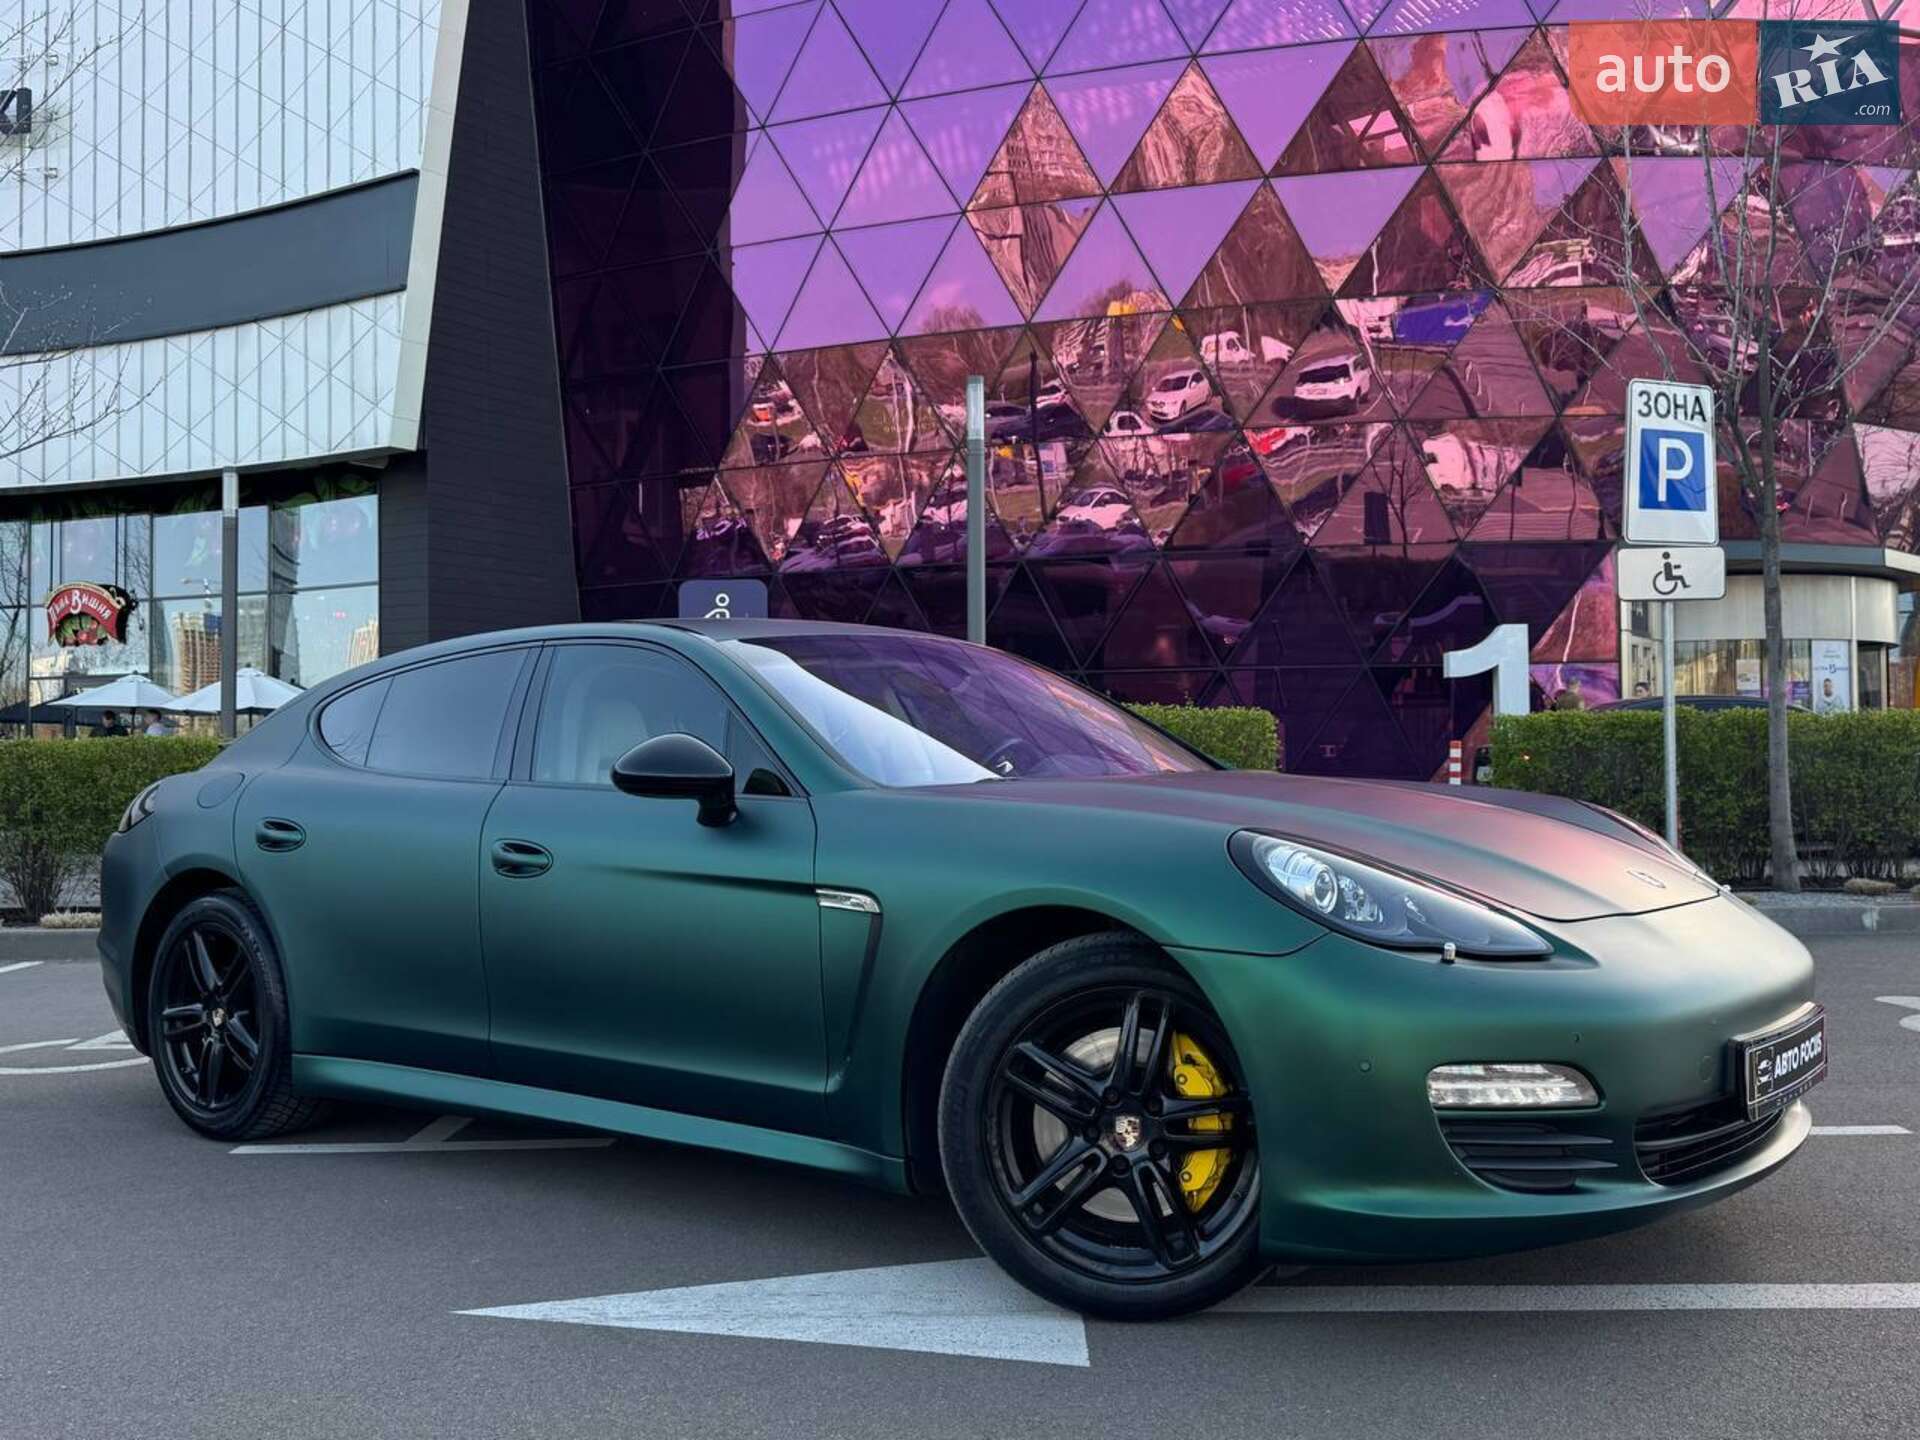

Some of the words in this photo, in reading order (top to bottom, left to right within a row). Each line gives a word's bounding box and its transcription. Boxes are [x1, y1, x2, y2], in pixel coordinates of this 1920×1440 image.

[1638, 390, 1707, 422] ЗОНА
[1658, 437, 1693, 502] P
[1443, 623, 1530, 716] 1
